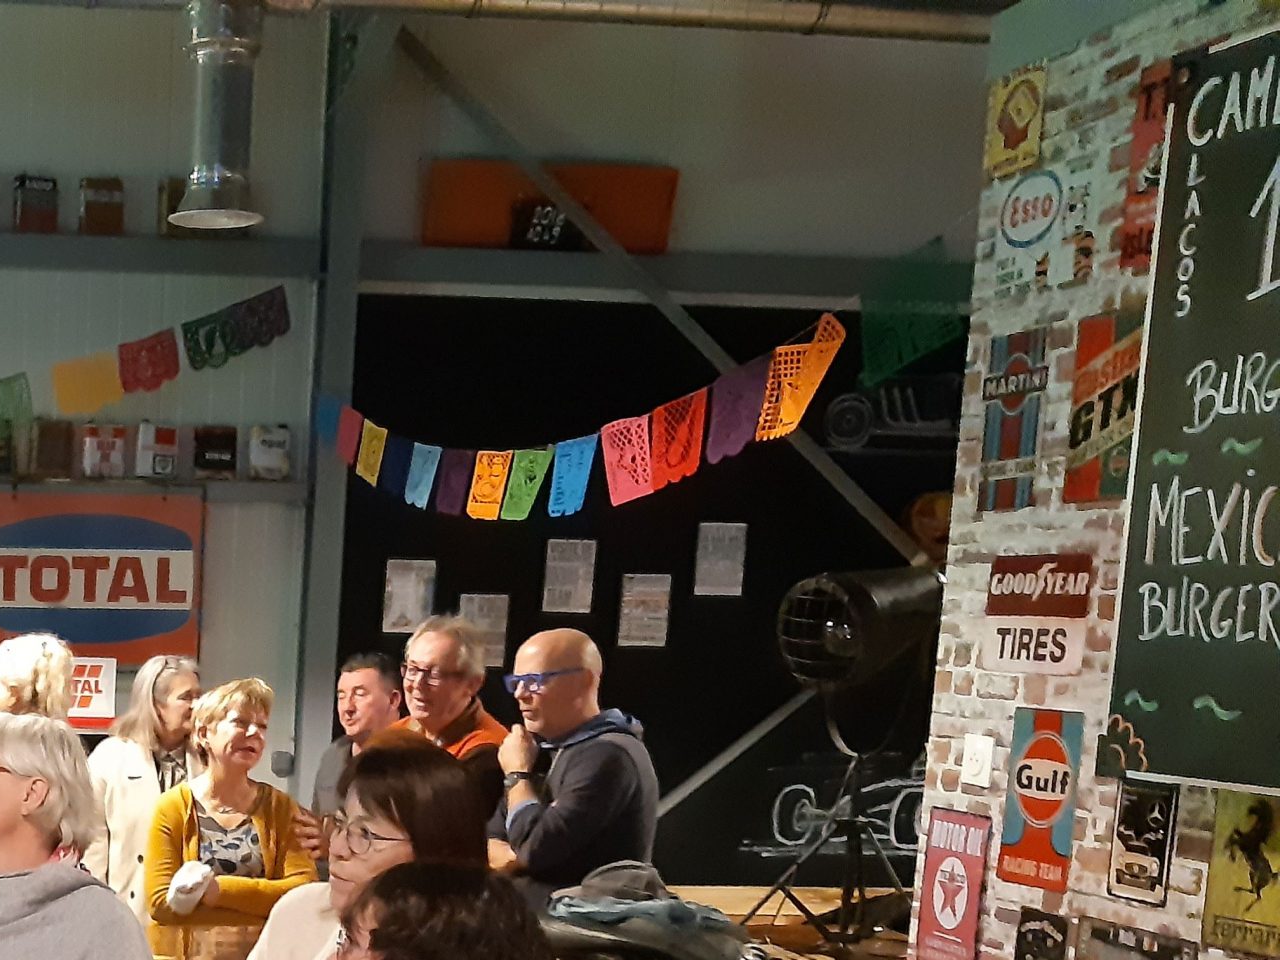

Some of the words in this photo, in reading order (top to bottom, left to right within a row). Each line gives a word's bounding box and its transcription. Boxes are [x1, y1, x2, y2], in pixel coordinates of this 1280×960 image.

[1144, 474, 1280, 567] MEXIC
[990, 565, 1090, 600] GOODYEAR
[1137, 575, 1280, 652] BURGER
[996, 627, 1067, 663] TIRES
[72, 679, 103, 694] TAL
[1015, 763, 1071, 796] Gulf
